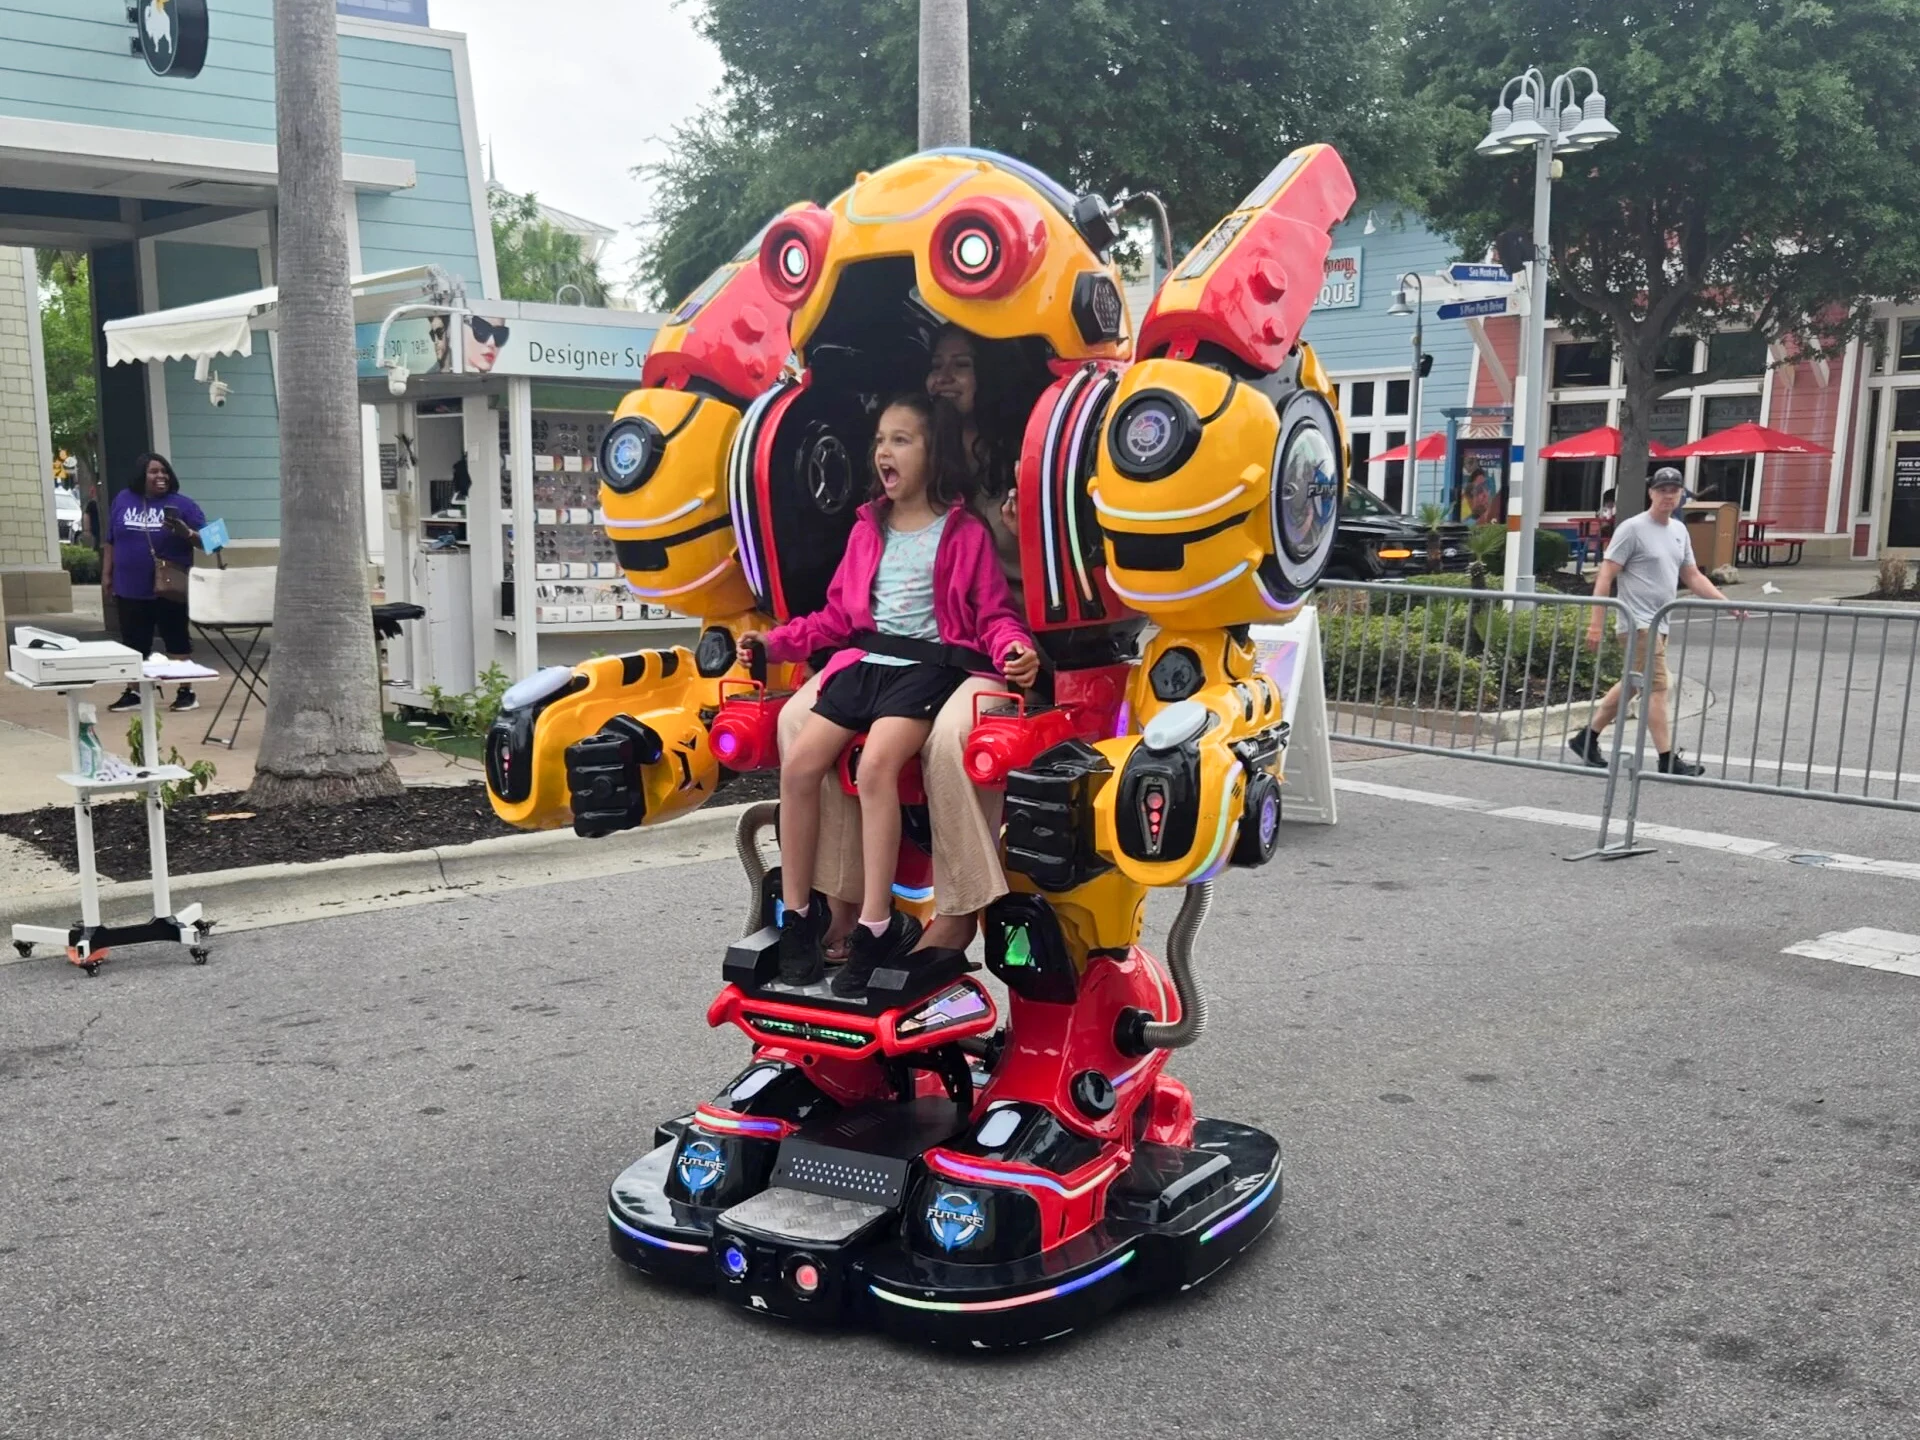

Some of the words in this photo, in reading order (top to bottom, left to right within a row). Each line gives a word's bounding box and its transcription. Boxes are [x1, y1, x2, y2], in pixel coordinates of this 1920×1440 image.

[529, 341, 618, 371] Designer
[677, 1155, 726, 1173] FUTURE
[926, 1208, 984, 1228] FUTURE
